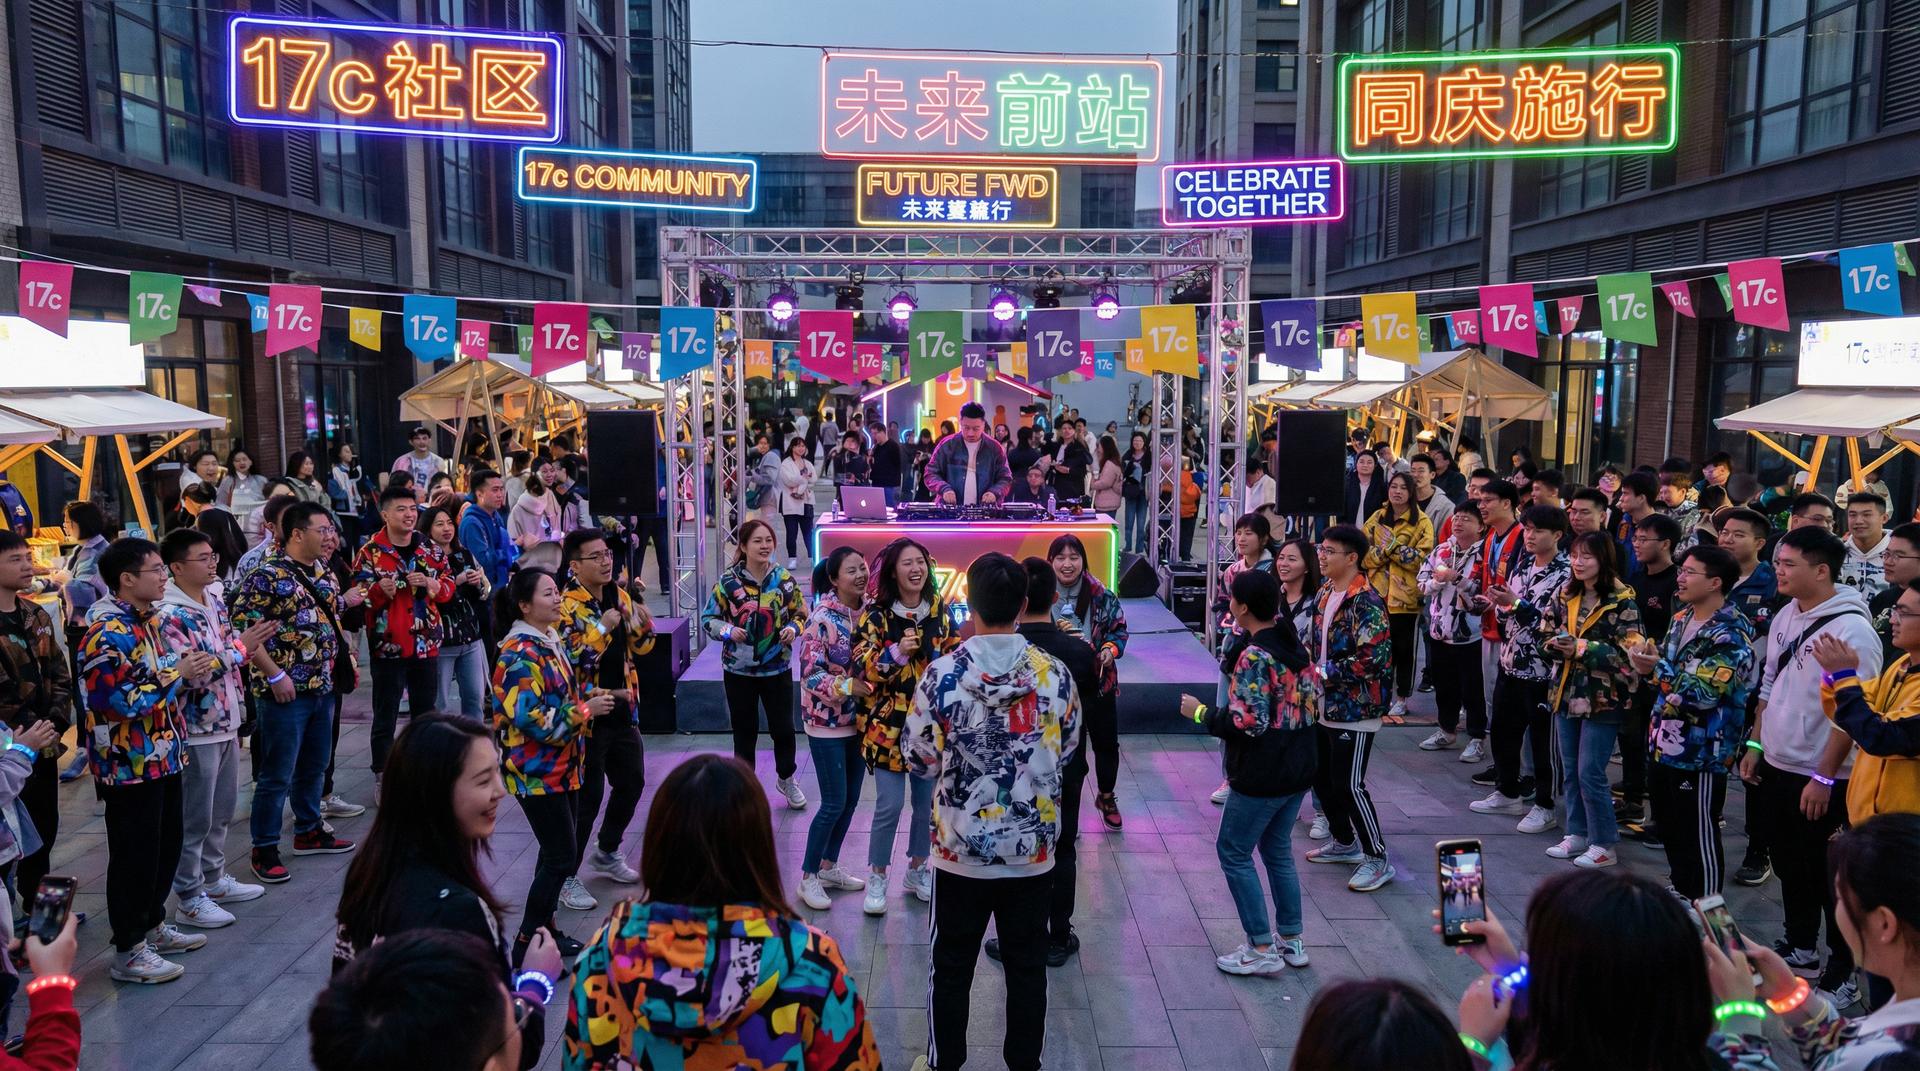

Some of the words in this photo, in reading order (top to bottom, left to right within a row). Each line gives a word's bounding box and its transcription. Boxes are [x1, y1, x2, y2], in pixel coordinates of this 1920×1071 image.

[244, 37, 546, 125] 17c社区
[835, 69, 1150, 148] 未来前站
[1355, 63, 1666, 146] 同庆施行
[525, 161, 568, 188] 17c
[575, 164, 750, 197] COMMUNITY
[867, 171, 977, 197] FUTURE
[985, 174, 1049, 198] FWD
[1175, 166, 1331, 193] CELEBRATE
[1180, 192, 1327, 218] TOGETHER
[1849, 265, 1890, 293] 17c
[26, 281, 62, 310] 17c
[1737, 279, 1777, 306] 17c
[137, 293, 171, 320] 17c
[255, 306, 268, 319] 17
[275, 304, 312, 331] 17c
[1488, 305, 1528, 332] 17c
[1607, 293, 1647, 321] 17c
[411, 315, 447, 342] 17c
[465, 331, 484, 346] 17c
[542, 324, 579, 350] 17c
[1149, 326, 1188, 352] 17c
[1271, 320, 1310, 346] 17c
[1371, 313, 1409, 341] 17c
[1457, 321, 1476, 334] 17c
[522, 337, 532, 351] 17
[627, 345, 646, 359] 17c
[668, 327, 706, 354] 17c
[807, 332, 845, 357] 17c
[917, 332, 955, 357] 17c
[1035, 331, 1073, 356] 17c
[860, 354, 880, 367] 17c
[965, 354, 984, 367] 17c
[1080, 351, 1091, 364] 7c
[1130, 349, 1143, 363] 17
